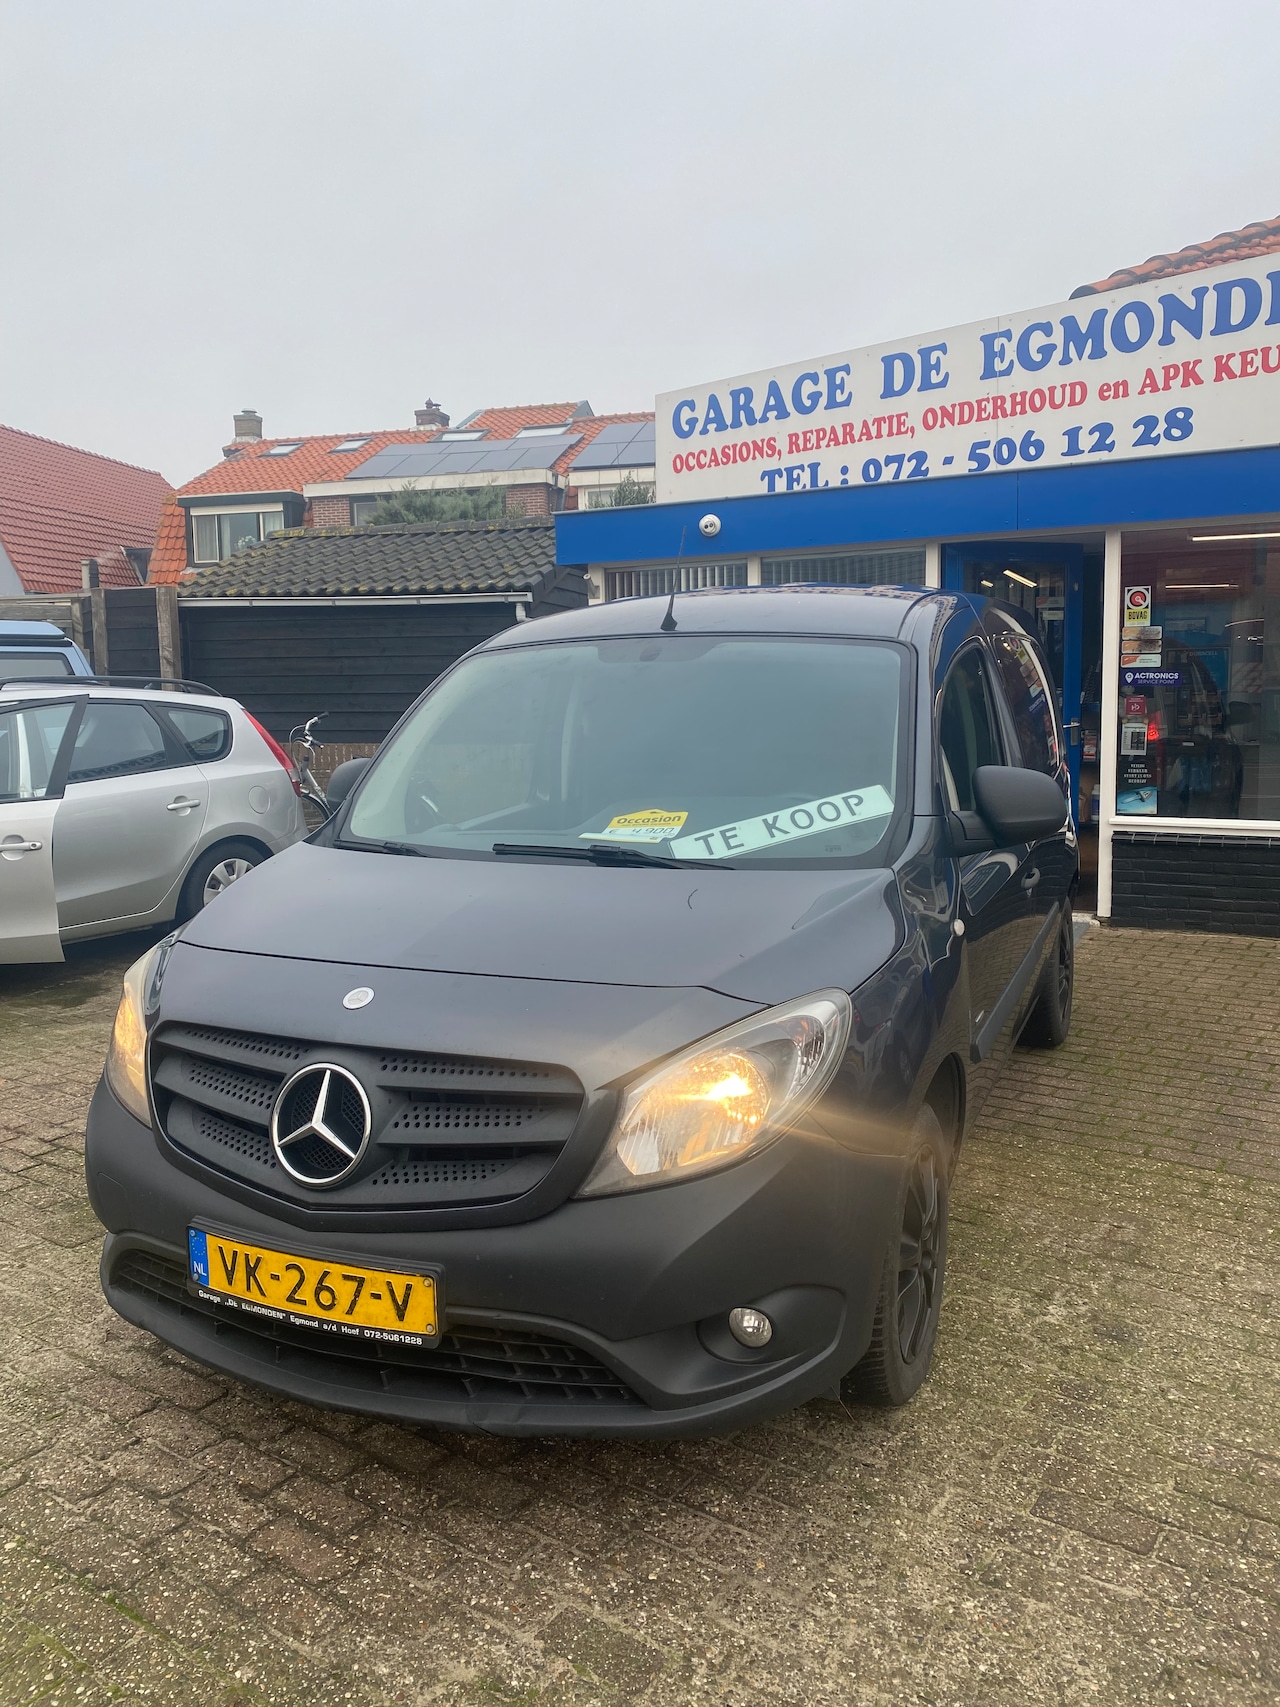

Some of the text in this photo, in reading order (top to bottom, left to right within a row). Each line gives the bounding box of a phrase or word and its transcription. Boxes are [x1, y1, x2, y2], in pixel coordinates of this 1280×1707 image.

[672, 364, 853, 438] GARAGE
[880, 343, 949, 399] DE
[672, 437, 783, 474] OCCASIONS,
[787, 413, 915, 454] REPARATIE,
[922, 381, 1088, 431] ONDERHOUD
[1098, 379, 1130, 402] en
[1138, 359, 1204, 395] APK
[862, 450, 930, 483] 072
[968, 430, 1046, 473] 506
[1062, 422, 1116, 456] 12
[1133, 407, 1194, 446] 28
[1128, 611, 1148, 620] BOVAG
[617, 815, 682, 824] Occasion
[694, 794, 864, 855] TE KOOP
[193, 1260, 208, 1277] NL
[218, 1245, 413, 1322] VK-267-V
[198, 1289, 221, 1304] Garage
[290, 1314, 319, 1328] Egmond
[322, 1323, 338, 1332] a/d
[341, 1325, 360, 1336] Hoef
[363, 1329, 423, 1346] 072-5061228
